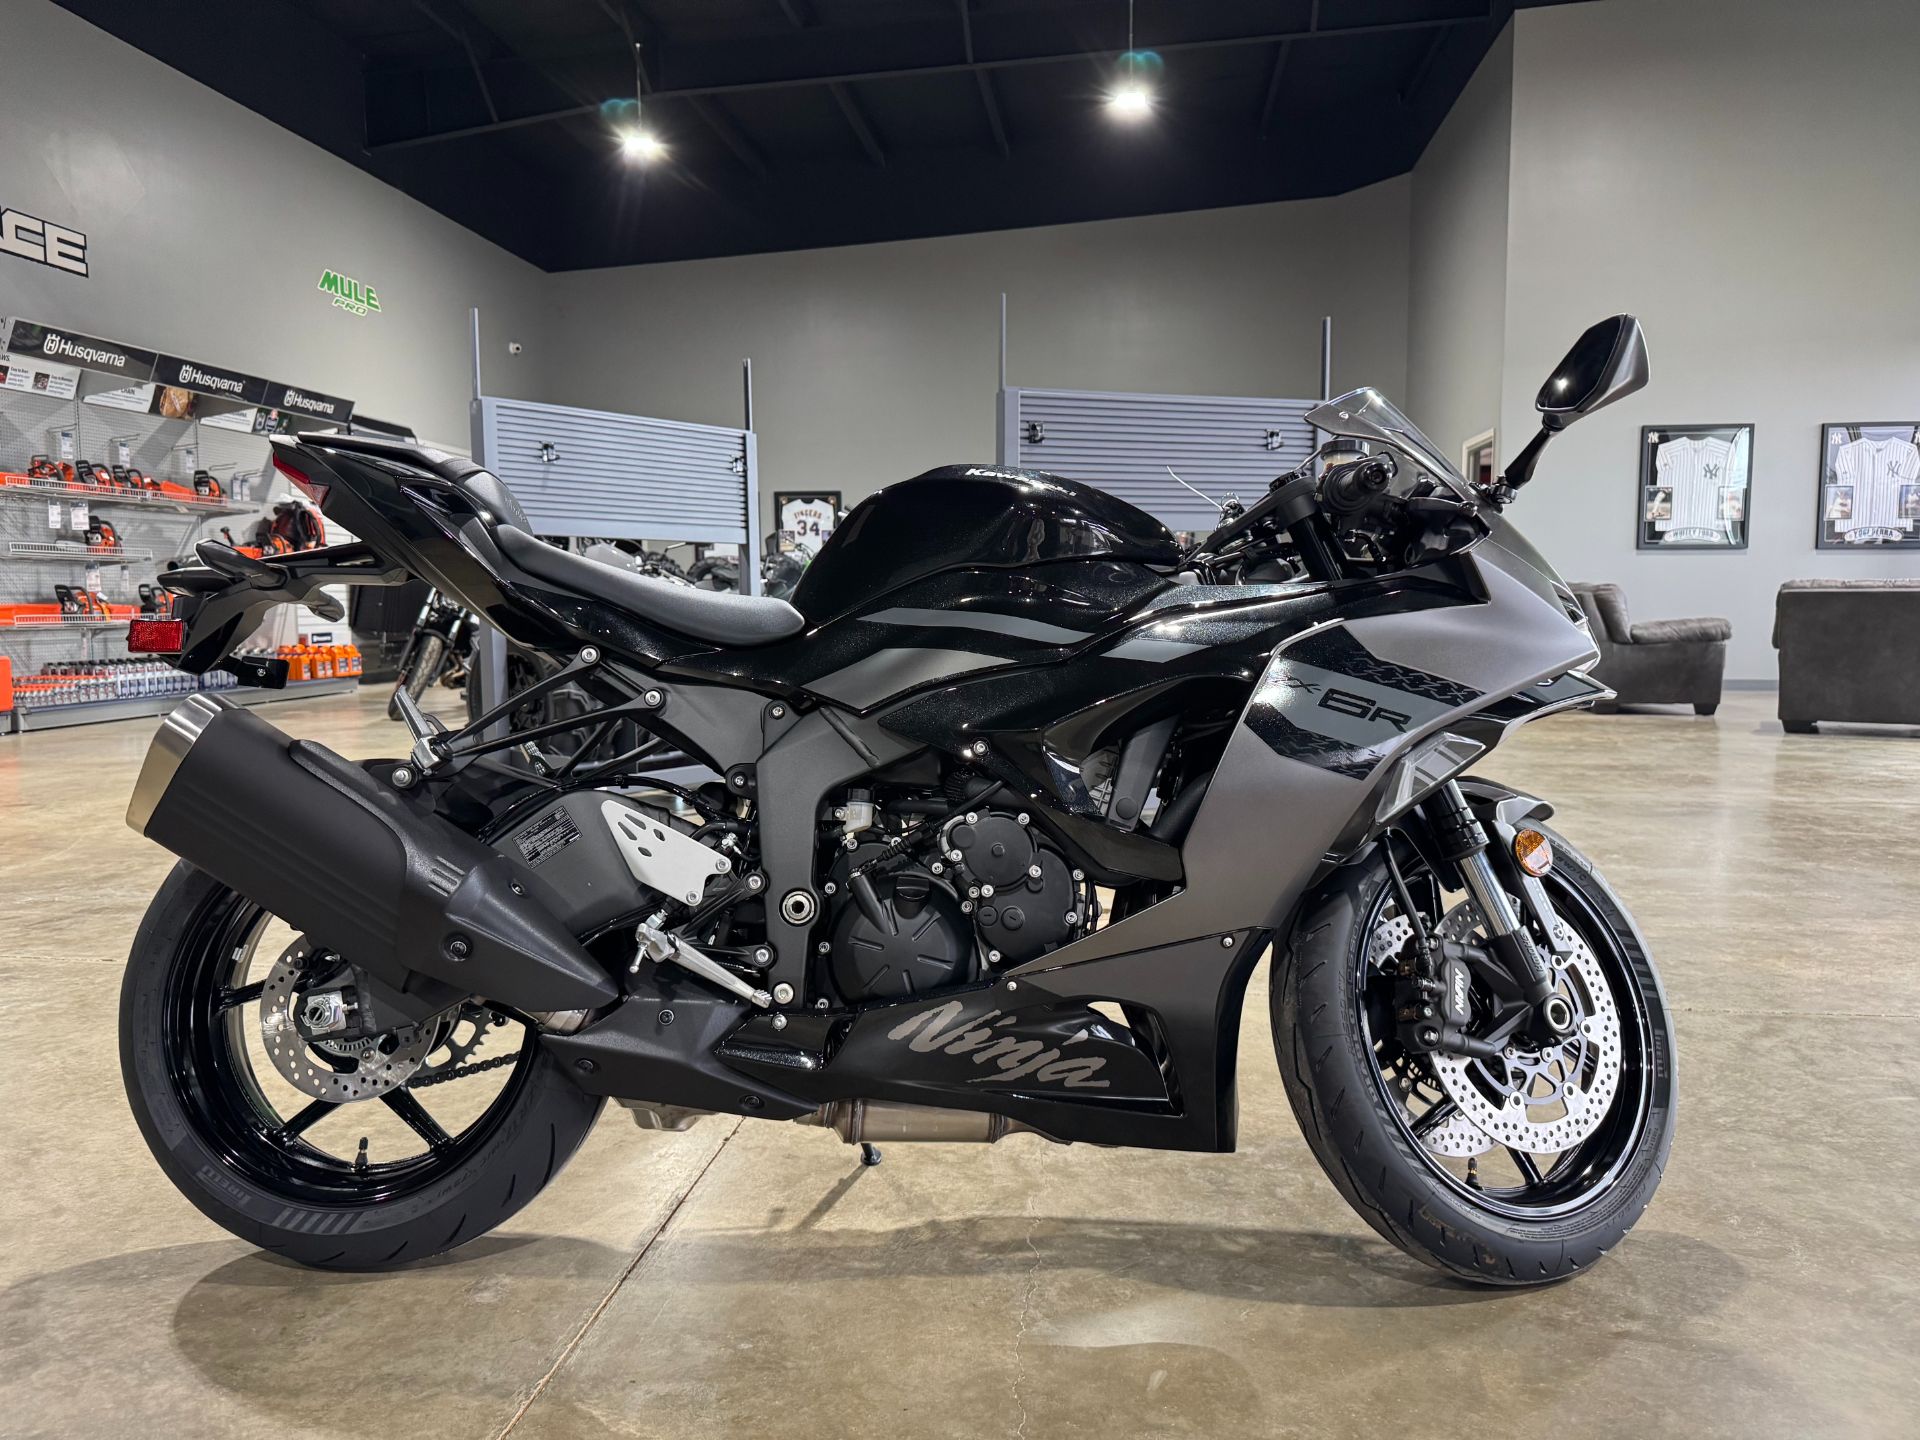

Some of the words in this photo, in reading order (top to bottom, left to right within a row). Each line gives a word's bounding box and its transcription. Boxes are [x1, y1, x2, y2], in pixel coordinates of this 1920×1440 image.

[0, 203, 89, 278] CE
[317, 268, 382, 312] MULE
[331, 296, 368, 317] PRO
[58, 339, 126, 367] Husqvarna
[190, 369, 243, 393] Husqvarna
[293, 393, 335, 415] Husqvarna
[797, 520, 820, 536] 34
[887, 1000, 1111, 1088] Ninja
